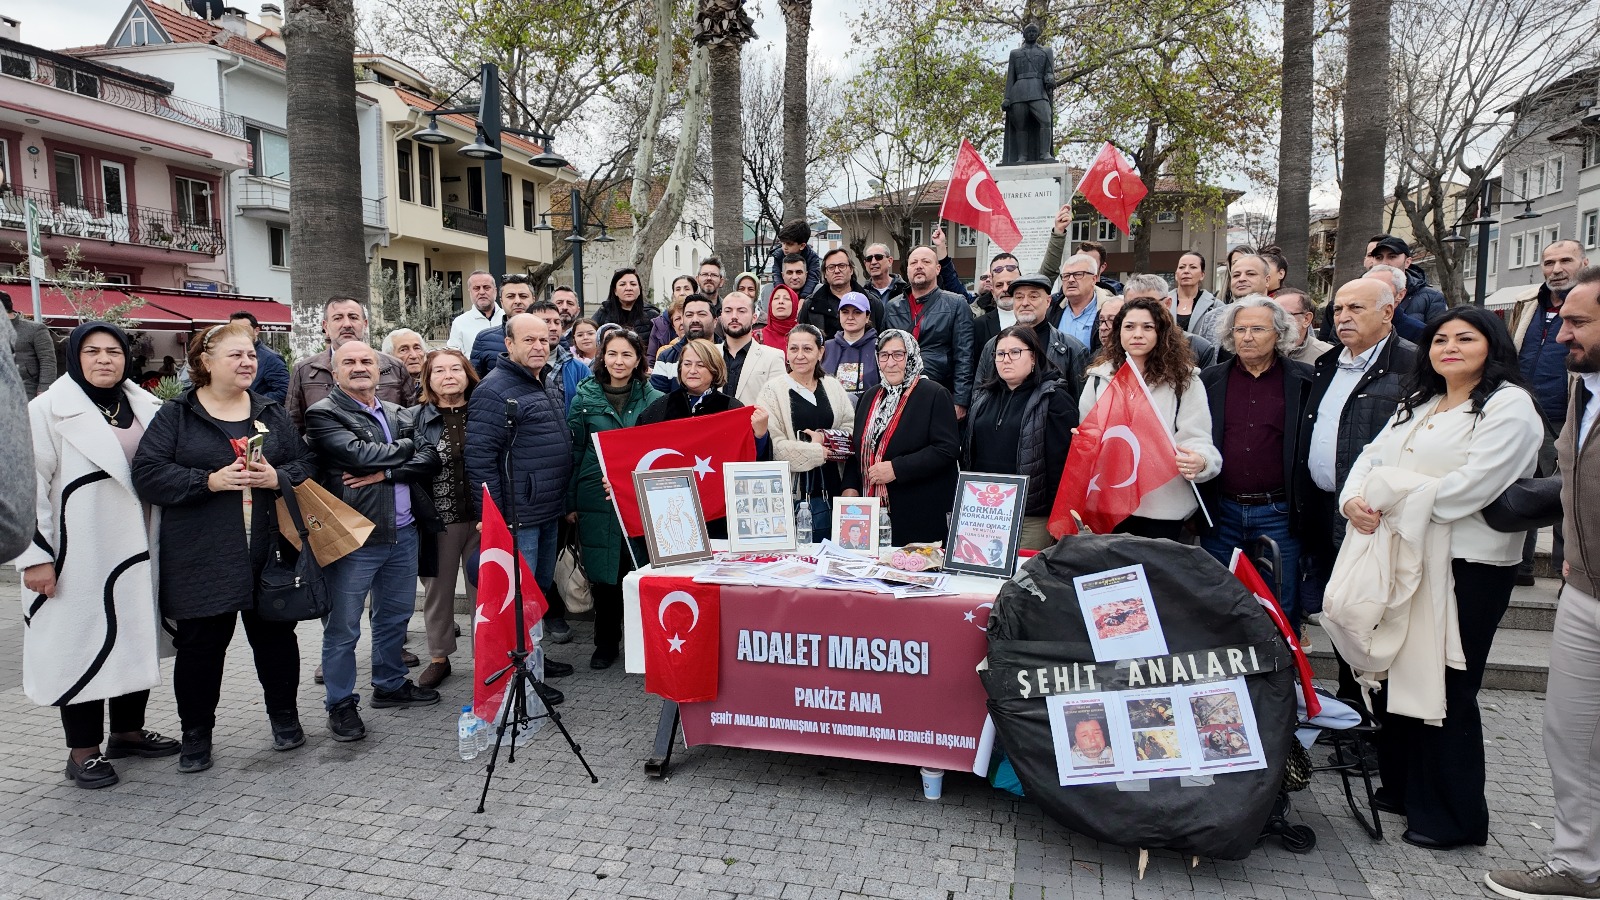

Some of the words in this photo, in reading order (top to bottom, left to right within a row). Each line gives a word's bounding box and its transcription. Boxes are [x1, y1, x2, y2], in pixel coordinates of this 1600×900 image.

[960, 520, 985, 528] VATANI
[961, 512, 1011, 522] KORKAKLARIN
[737, 629, 821, 667] ADALET
[828, 635, 929, 675] MASASI
[1017, 662, 1097, 699] ŞEHİT
[1128, 646, 1260, 687] ANALARI
[794, 686, 846, 711] PAKİZE
[849, 692, 882, 714] ANA
[710, 711, 733, 726] ŞEHİT
[733, 713, 768, 728] ANALARI
[769, 717, 819, 734] DAYANIŞMA
[819, 722, 830, 734] VE
[831, 723, 896, 741] YARDIMLAŞMA
[897, 729, 934, 745] DERNEĞİ
[935, 733, 976, 750] BAŞKANI
